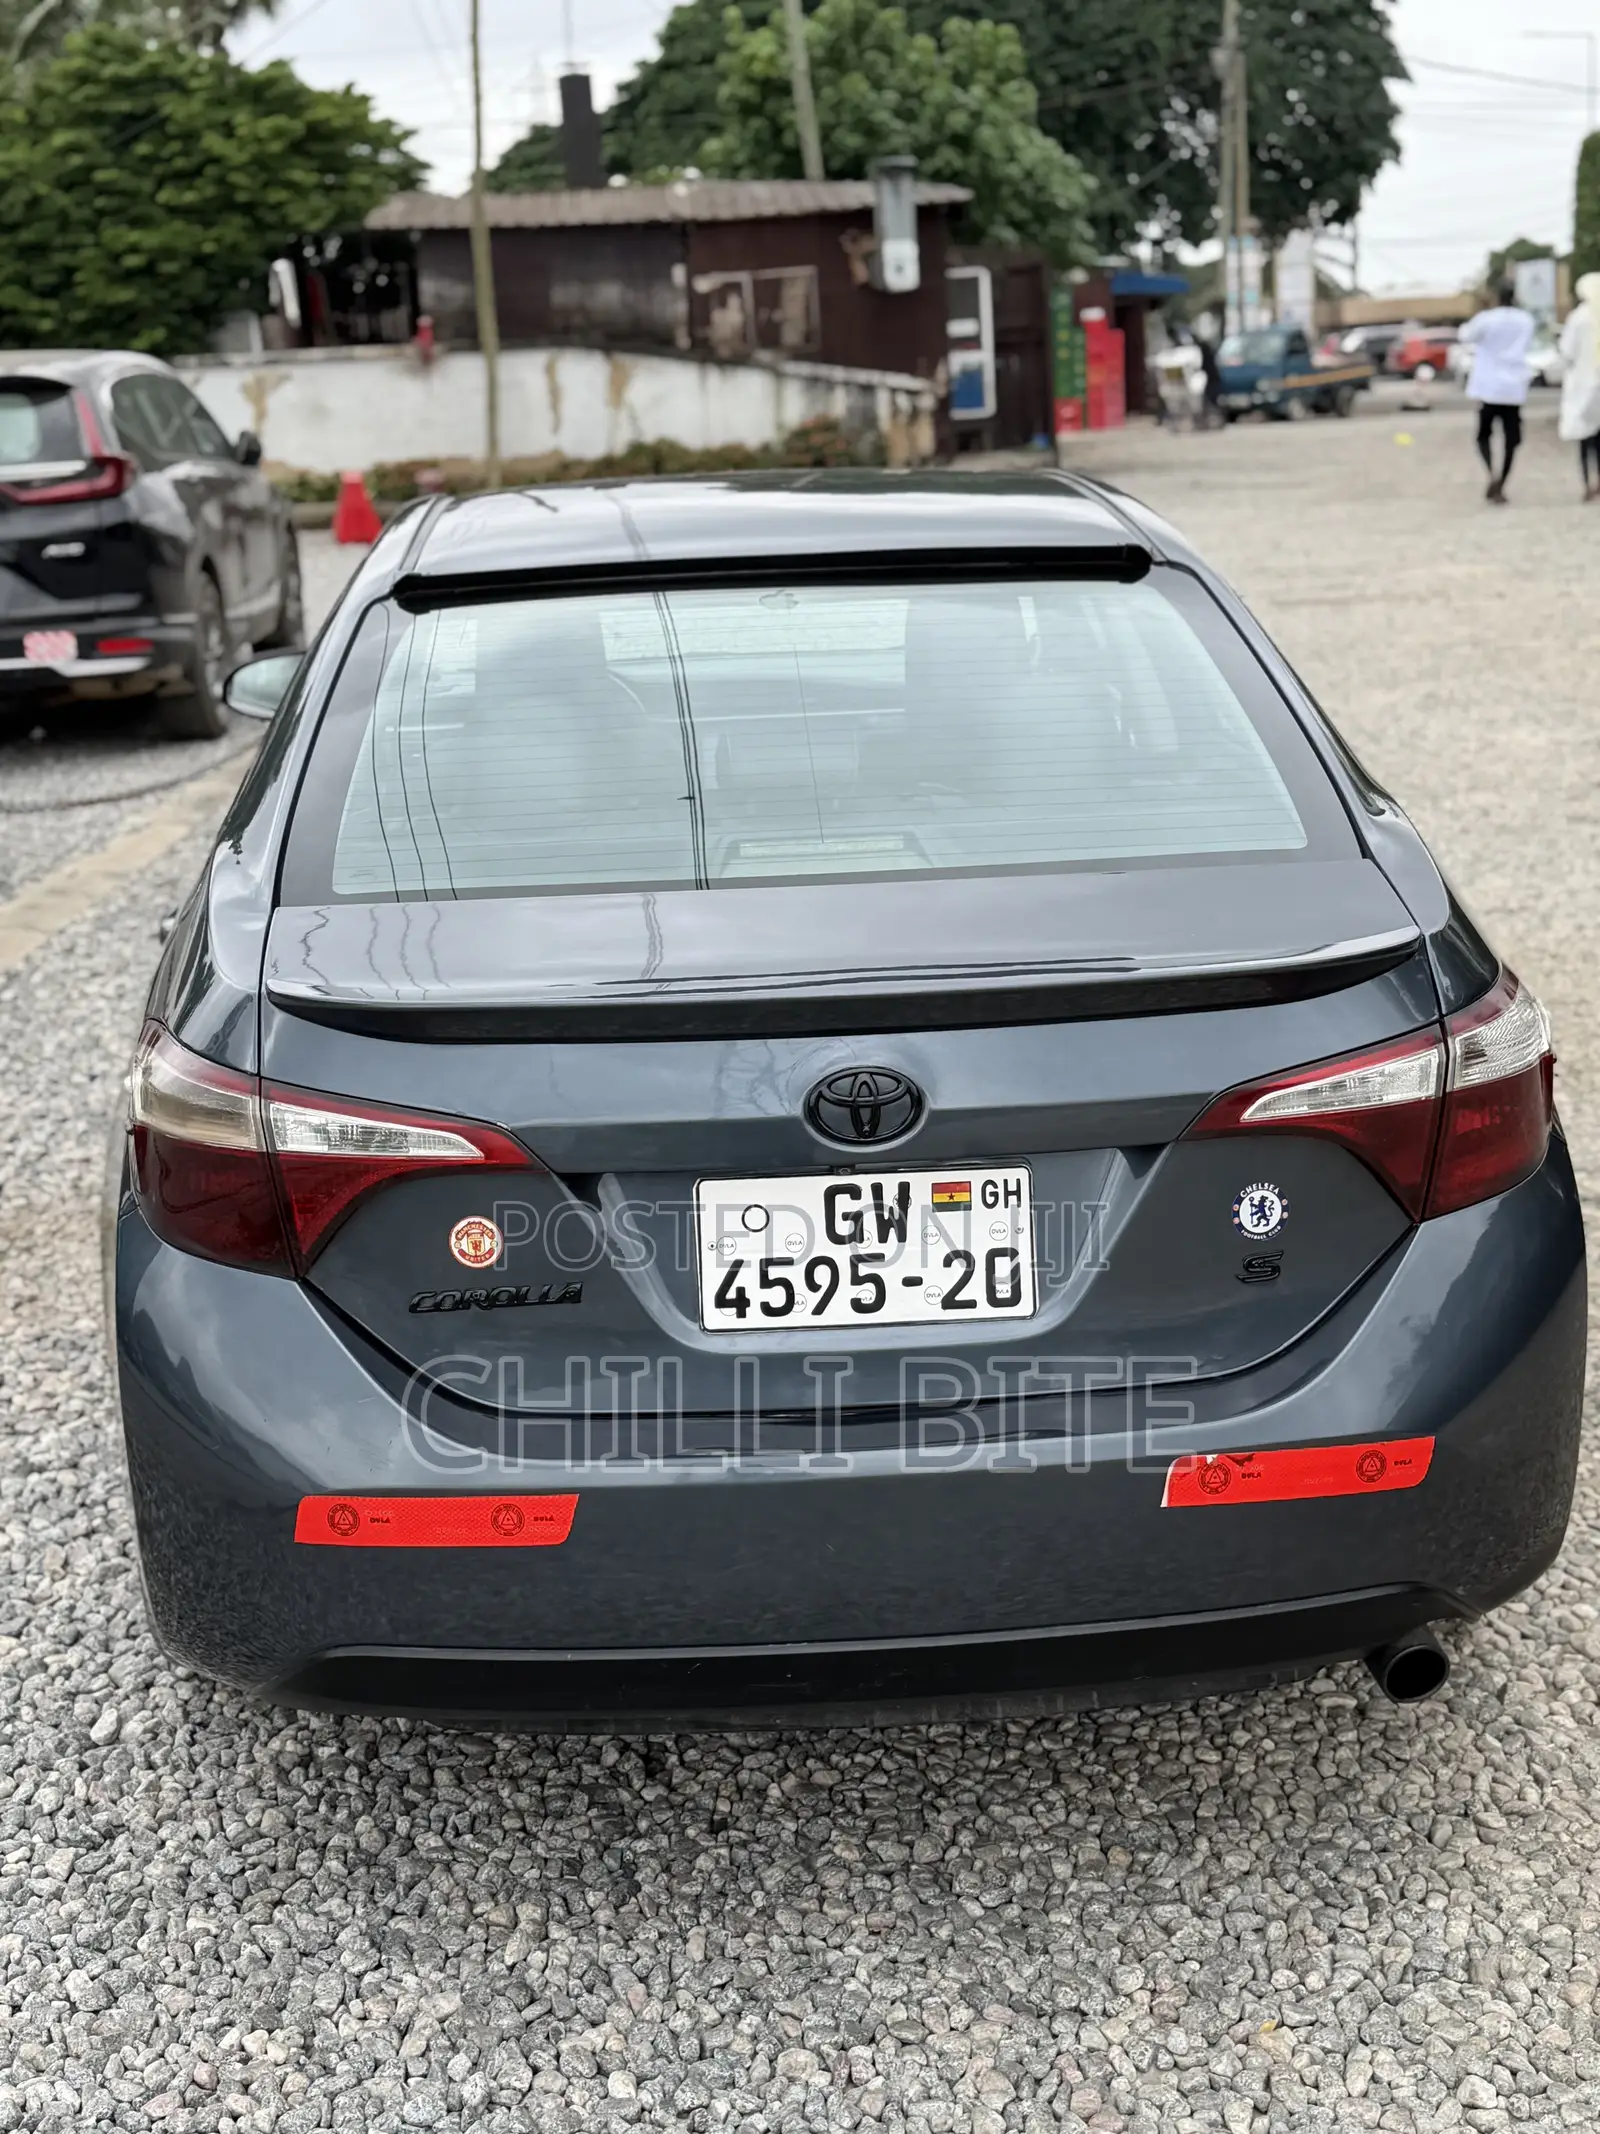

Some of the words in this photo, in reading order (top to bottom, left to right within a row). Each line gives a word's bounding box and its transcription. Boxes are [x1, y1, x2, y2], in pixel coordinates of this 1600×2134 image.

[981, 1177, 1022, 1209] GH
[1240, 1182, 1280, 1198] CHELSEA
[823, 1181, 911, 1246] GW
[1236, 1250, 1284, 1283] S
[409, 1281, 583, 1313] COROLLA
